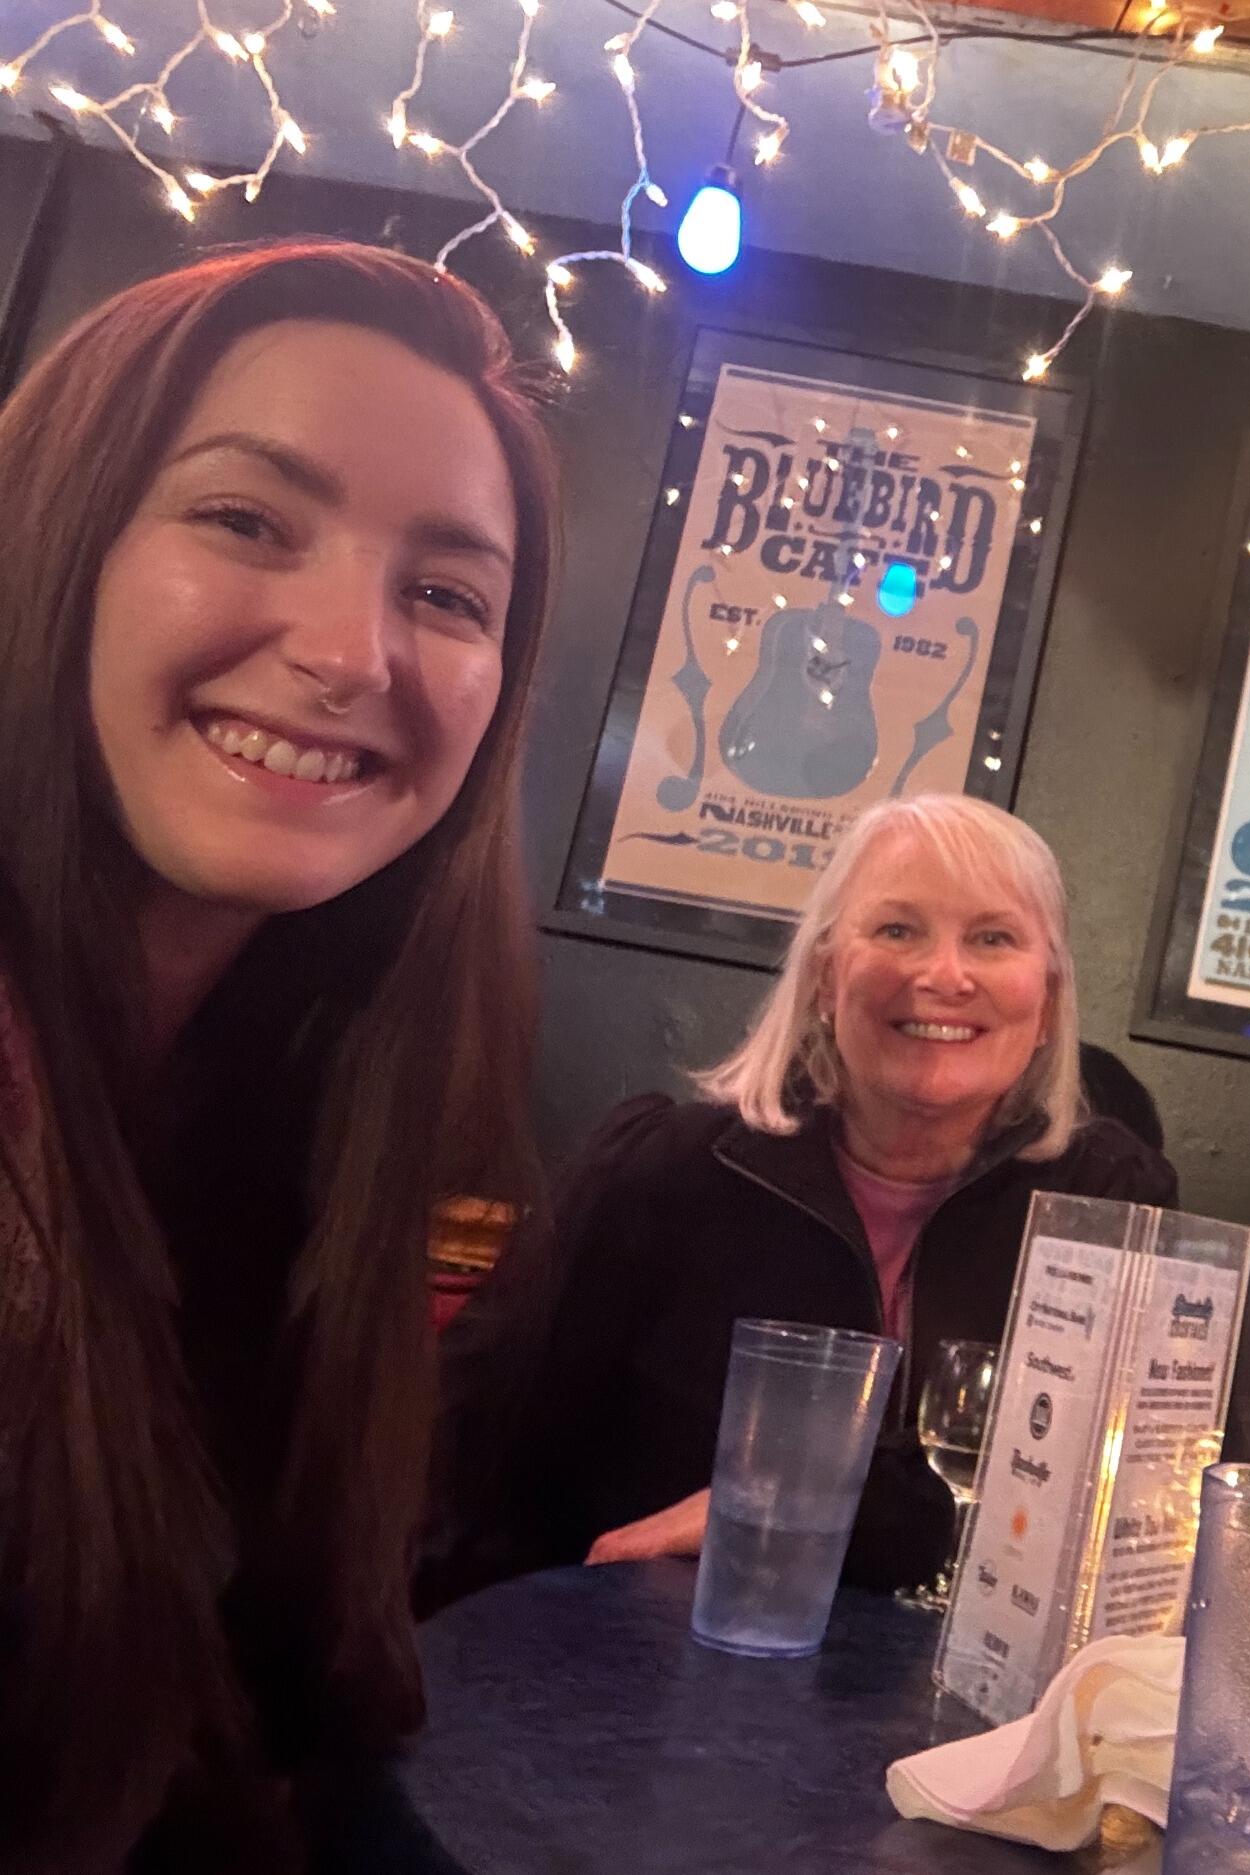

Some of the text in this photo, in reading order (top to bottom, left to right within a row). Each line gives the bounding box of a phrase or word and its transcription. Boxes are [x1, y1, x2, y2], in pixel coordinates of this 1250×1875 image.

[818, 438, 921, 472] THE
[701, 443, 997, 594] BLUEBIRD
[709, 603, 762, 626] EST.
[894, 635, 948, 661] 1982
